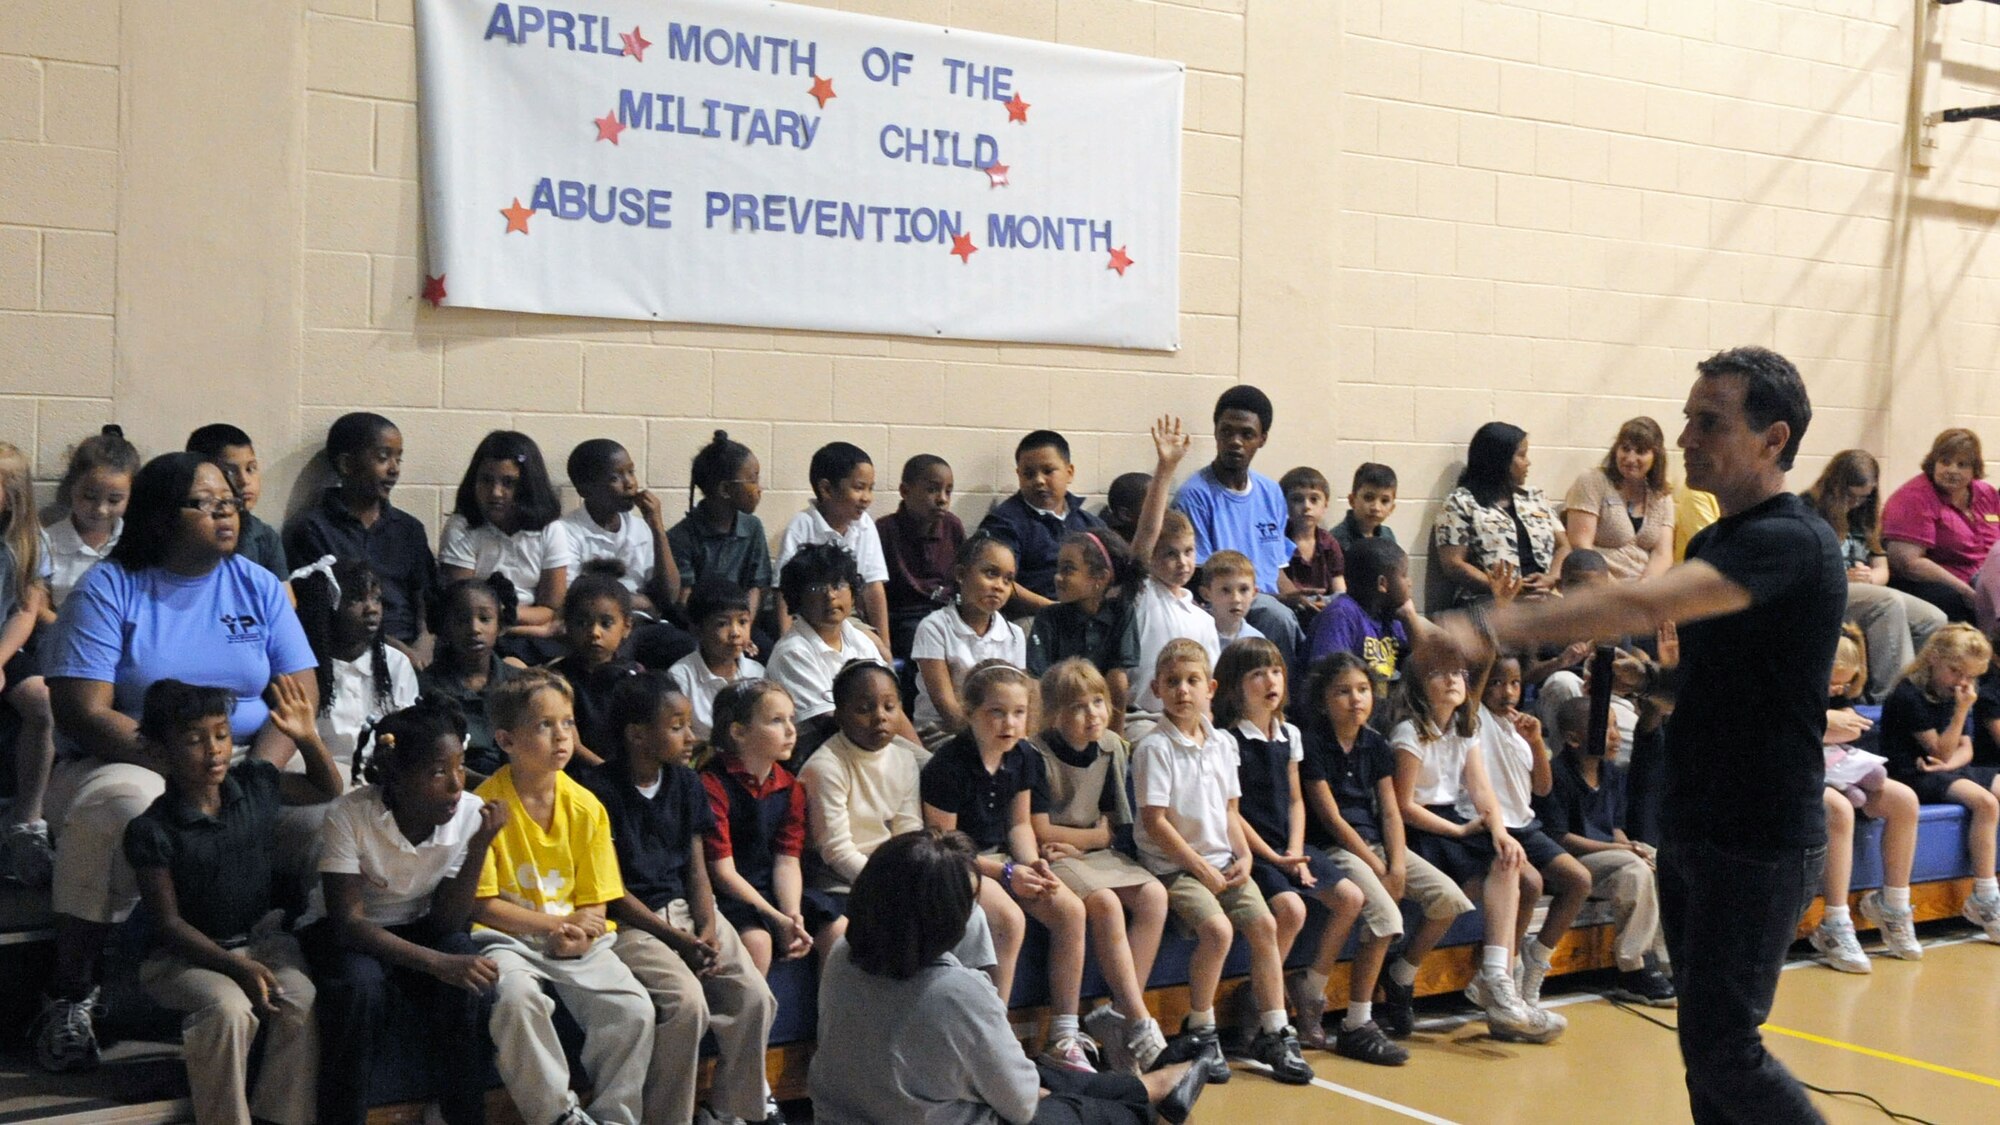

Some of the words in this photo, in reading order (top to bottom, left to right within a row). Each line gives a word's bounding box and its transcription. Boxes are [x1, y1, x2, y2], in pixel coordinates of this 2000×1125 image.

[484, 2, 625, 57] APRIL
[667, 22, 817, 78] MONTH
[861, 46, 914, 87] OF
[942, 58, 1014, 103] THE
[879, 123, 999, 171] CHILD
[529, 176, 673, 230] ABUSE
[704, 191, 962, 245] PREVENTION
[986, 213, 1113, 253] MONTH
